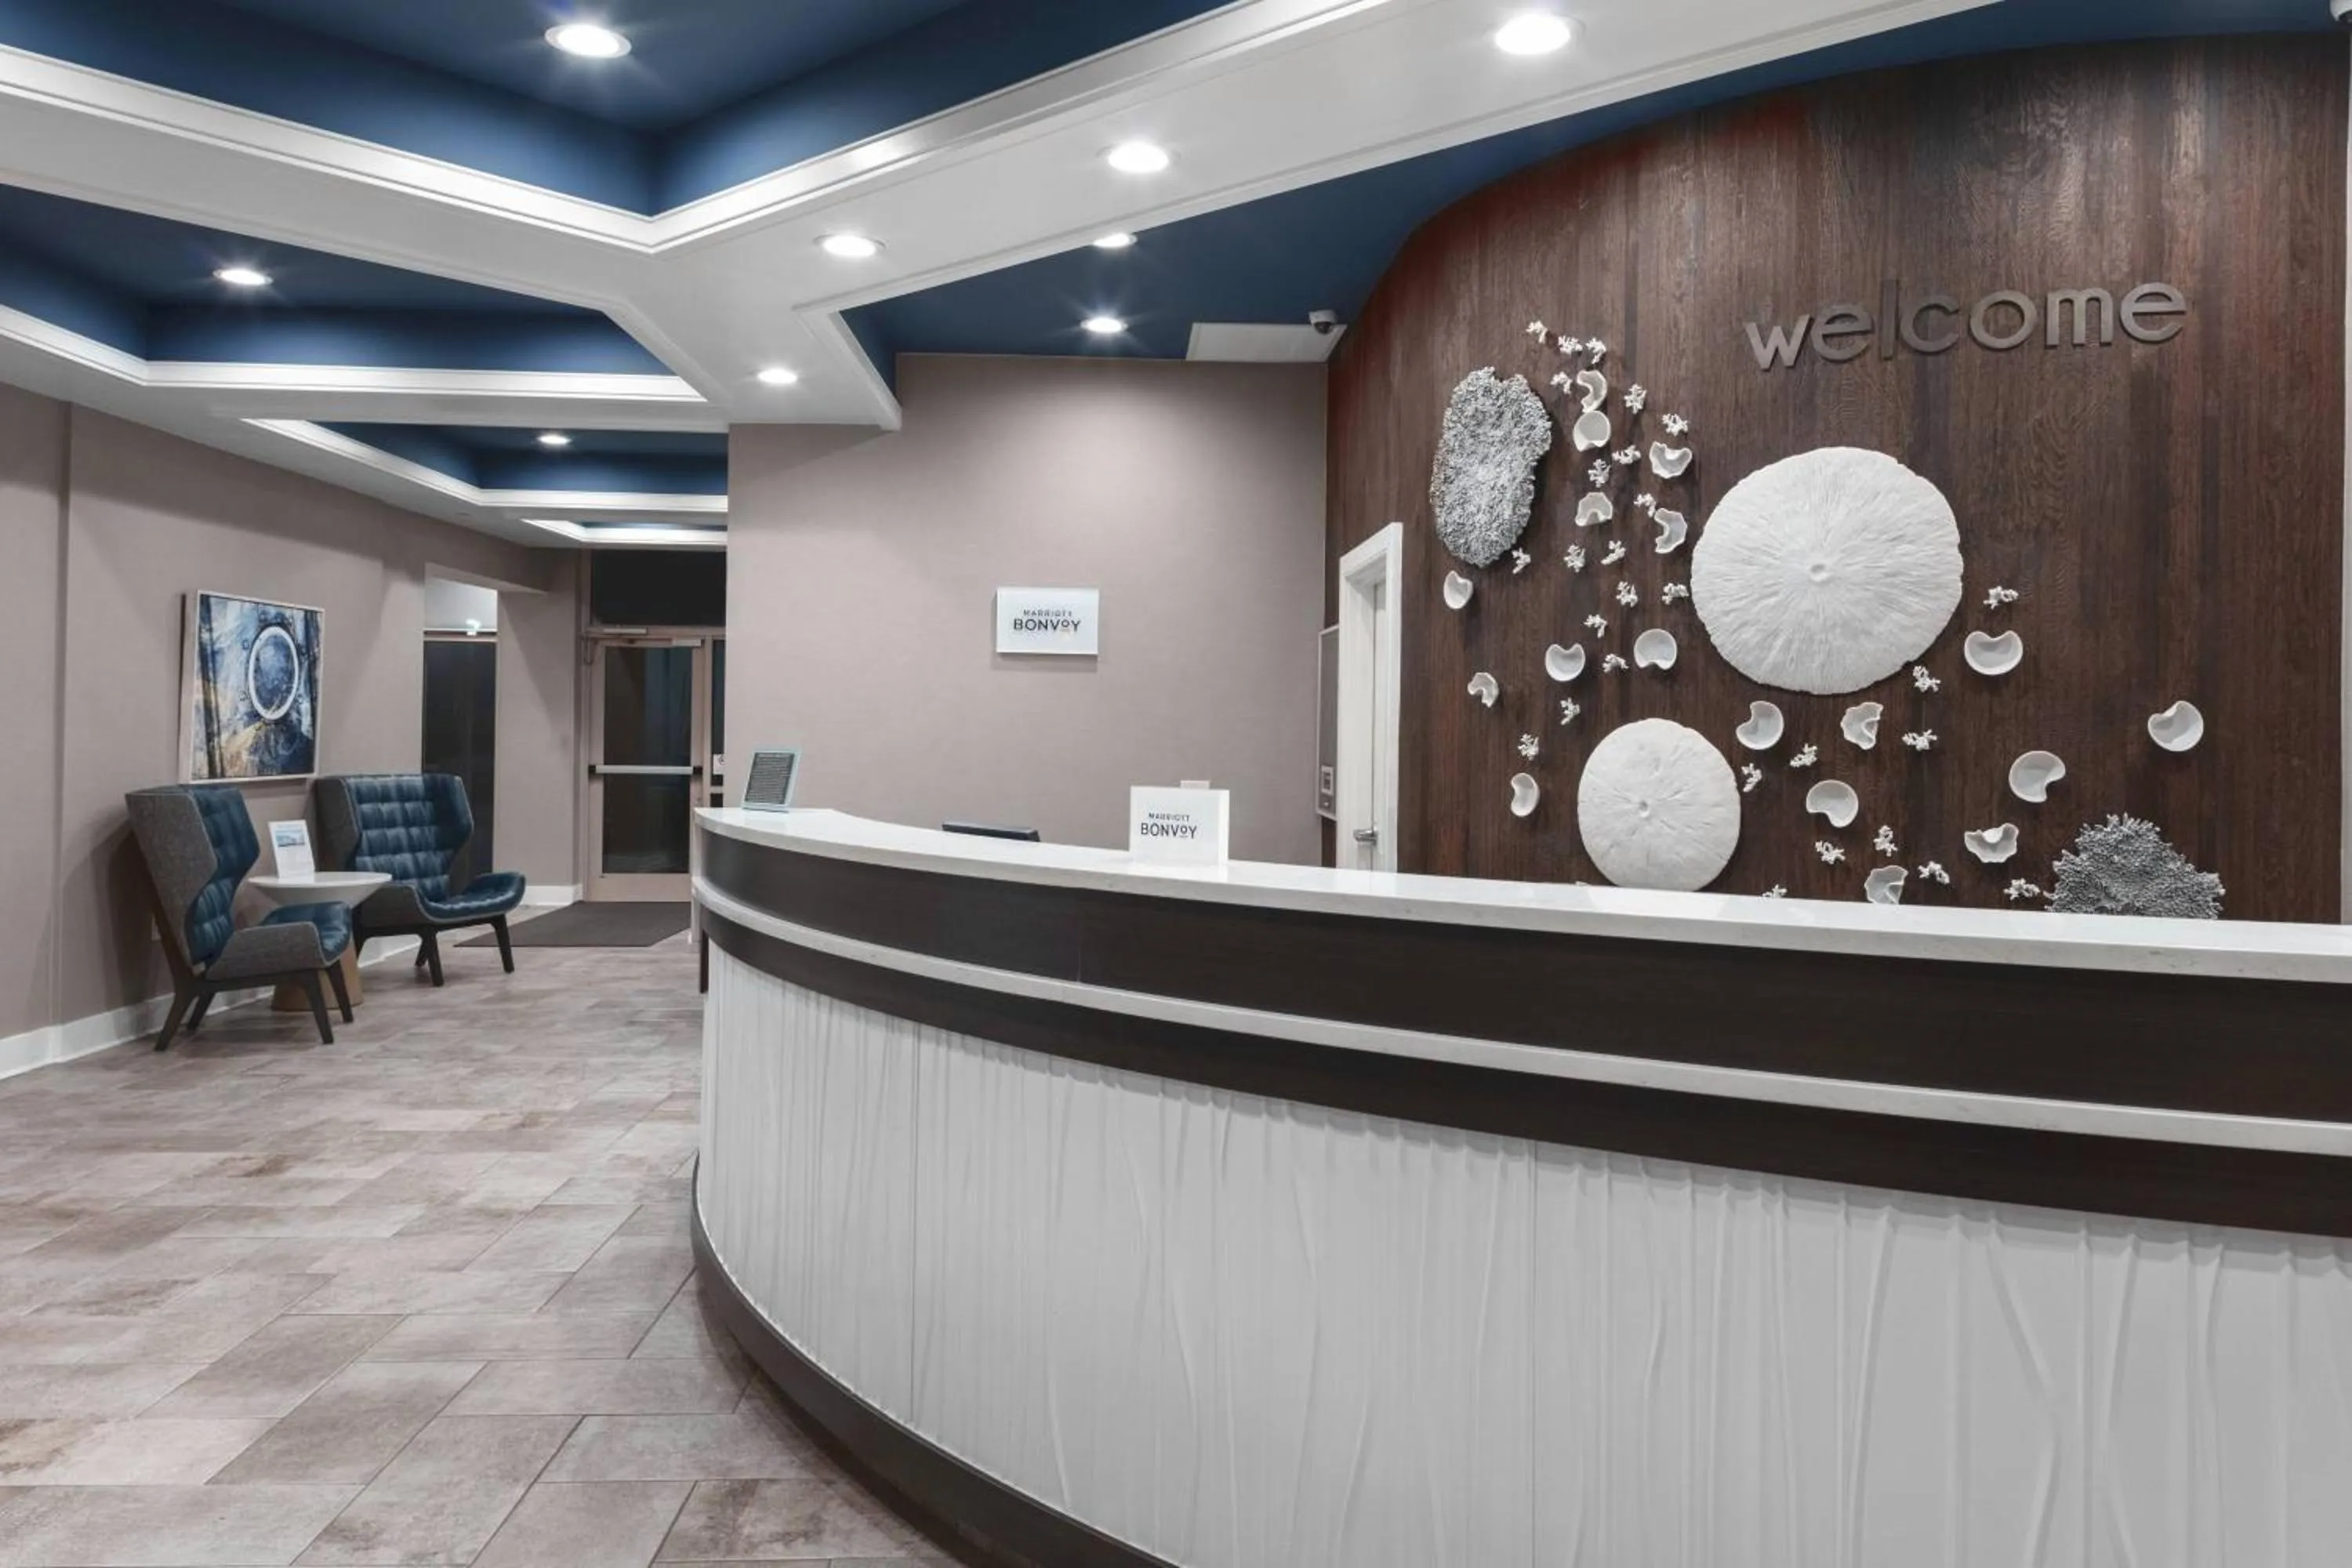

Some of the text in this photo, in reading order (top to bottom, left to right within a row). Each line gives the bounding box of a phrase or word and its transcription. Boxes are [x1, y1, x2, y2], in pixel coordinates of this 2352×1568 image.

[1744, 279, 2187, 372] welcome
[1013, 618, 1081, 632] BONVOY
[1148, 811, 1190, 822] MARRIOTT
[1141, 822, 1197, 839] BONVOY
